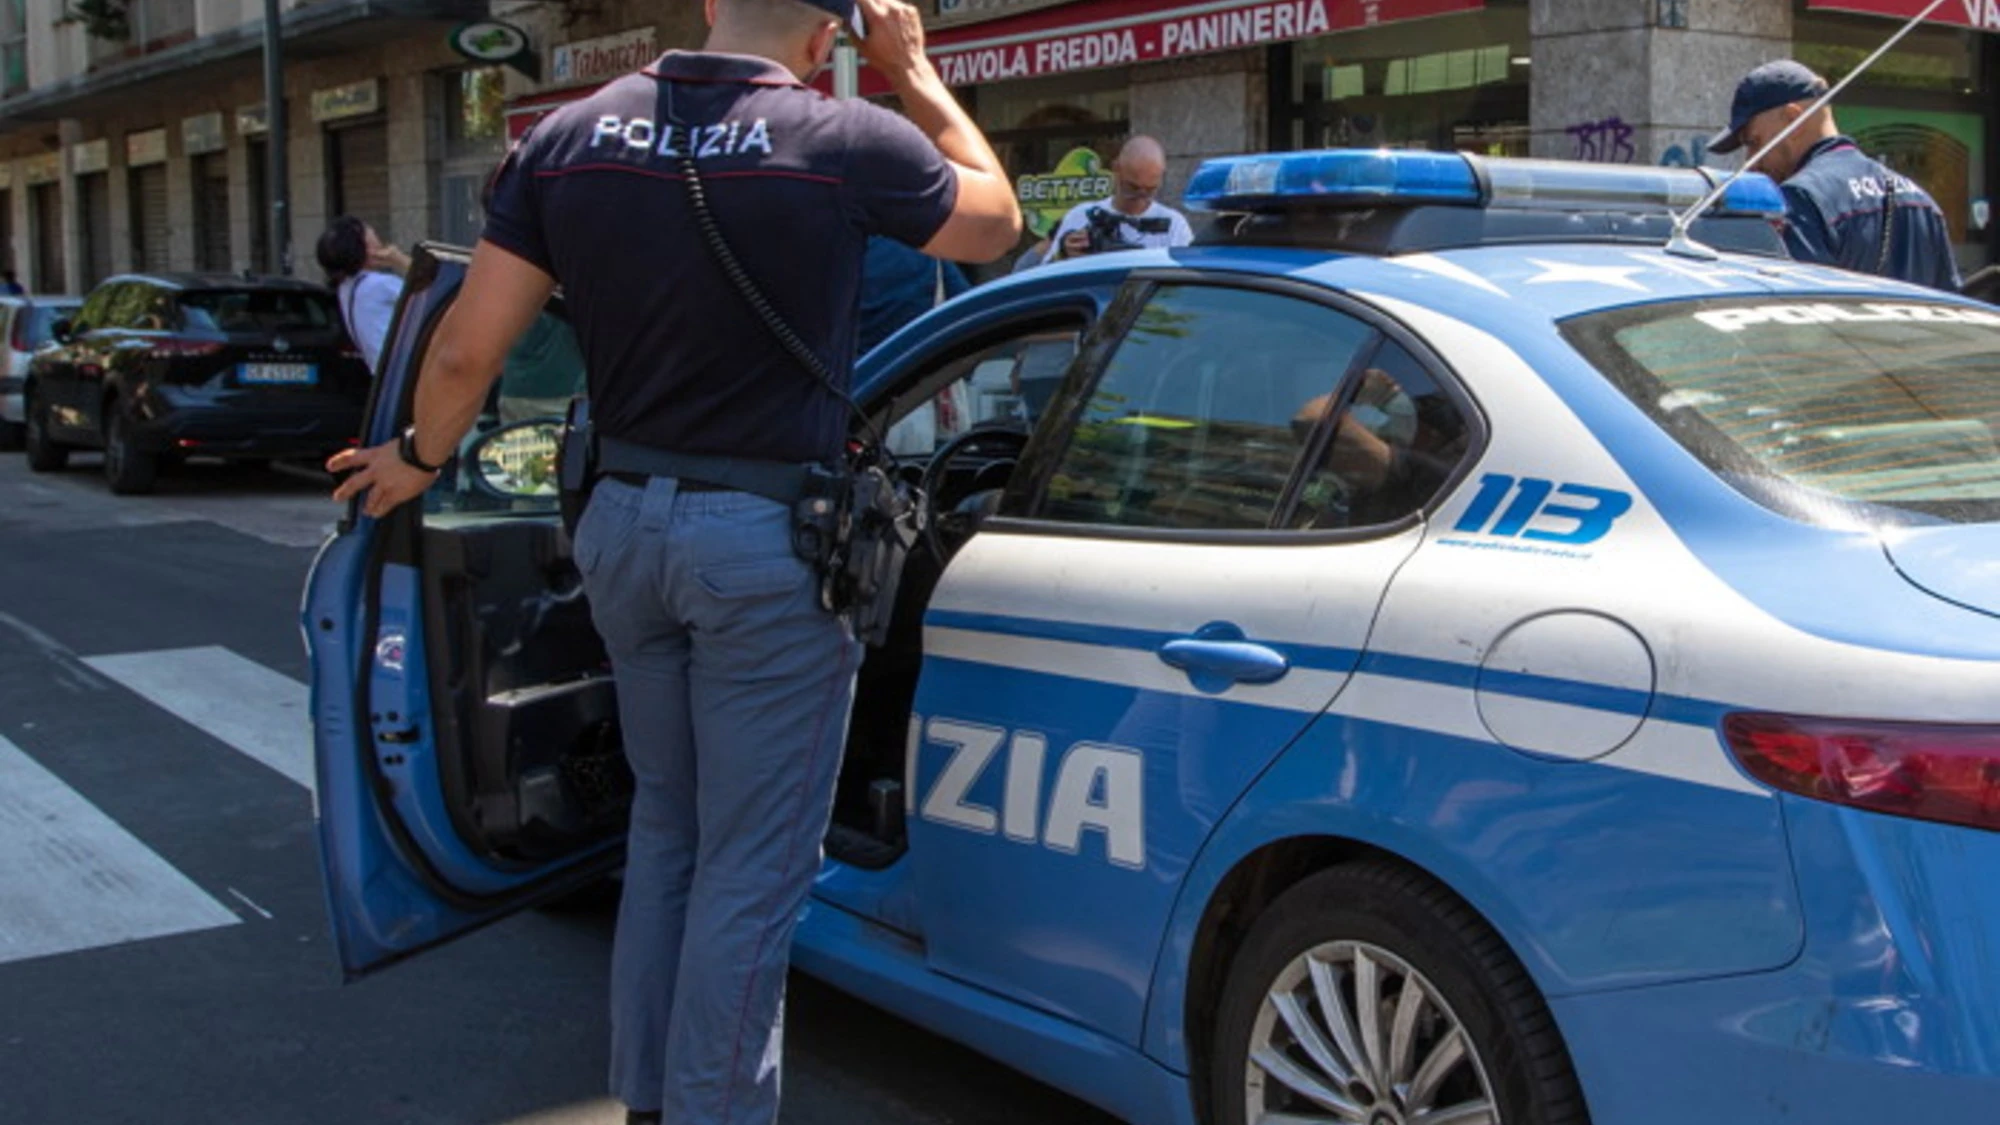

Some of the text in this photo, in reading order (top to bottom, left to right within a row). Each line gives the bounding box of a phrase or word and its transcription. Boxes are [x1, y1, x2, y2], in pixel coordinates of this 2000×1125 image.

[939, 45, 1029, 85] TAVOLA
[1036, 30, 1138, 74] FREDDA
[1162, 0, 1330, 57] PANINERIA
[590, 114, 773, 158] POLIZIA
[1018, 177, 1109, 200] BETTER
[1452, 472, 1633, 546] 113
